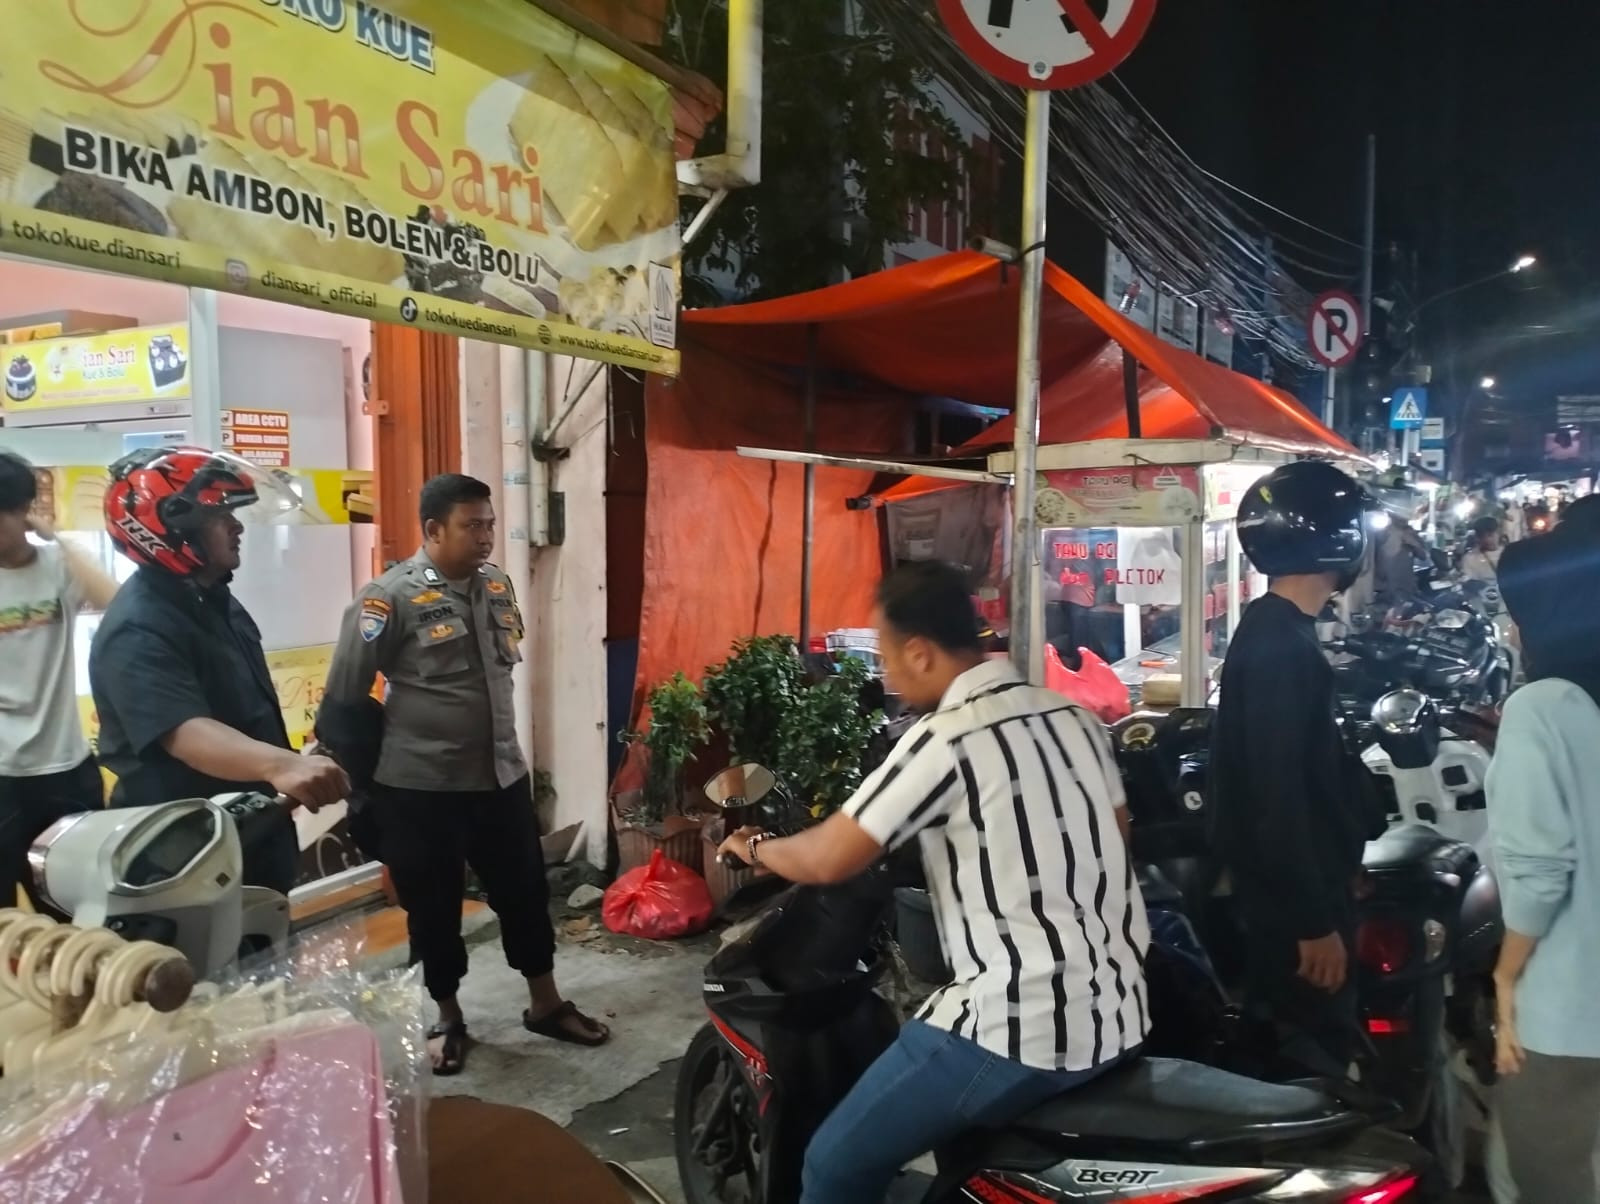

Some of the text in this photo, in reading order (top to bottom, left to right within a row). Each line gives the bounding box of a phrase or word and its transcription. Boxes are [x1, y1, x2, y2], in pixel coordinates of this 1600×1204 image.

[355, 2, 435, 74] KUE
[38, 0, 549, 235] Dian Sari
[65, 126, 539, 285] BIKA AMBON, BOLEN & BOLU
[13, 219, 181, 268] tokokue.diansari
[260, 269, 377, 308] diansari_official
[424, 308, 518, 338] tokokuediansari
[1324, 308, 1348, 352] P
[1103, 567, 1166, 585] PLETOK
